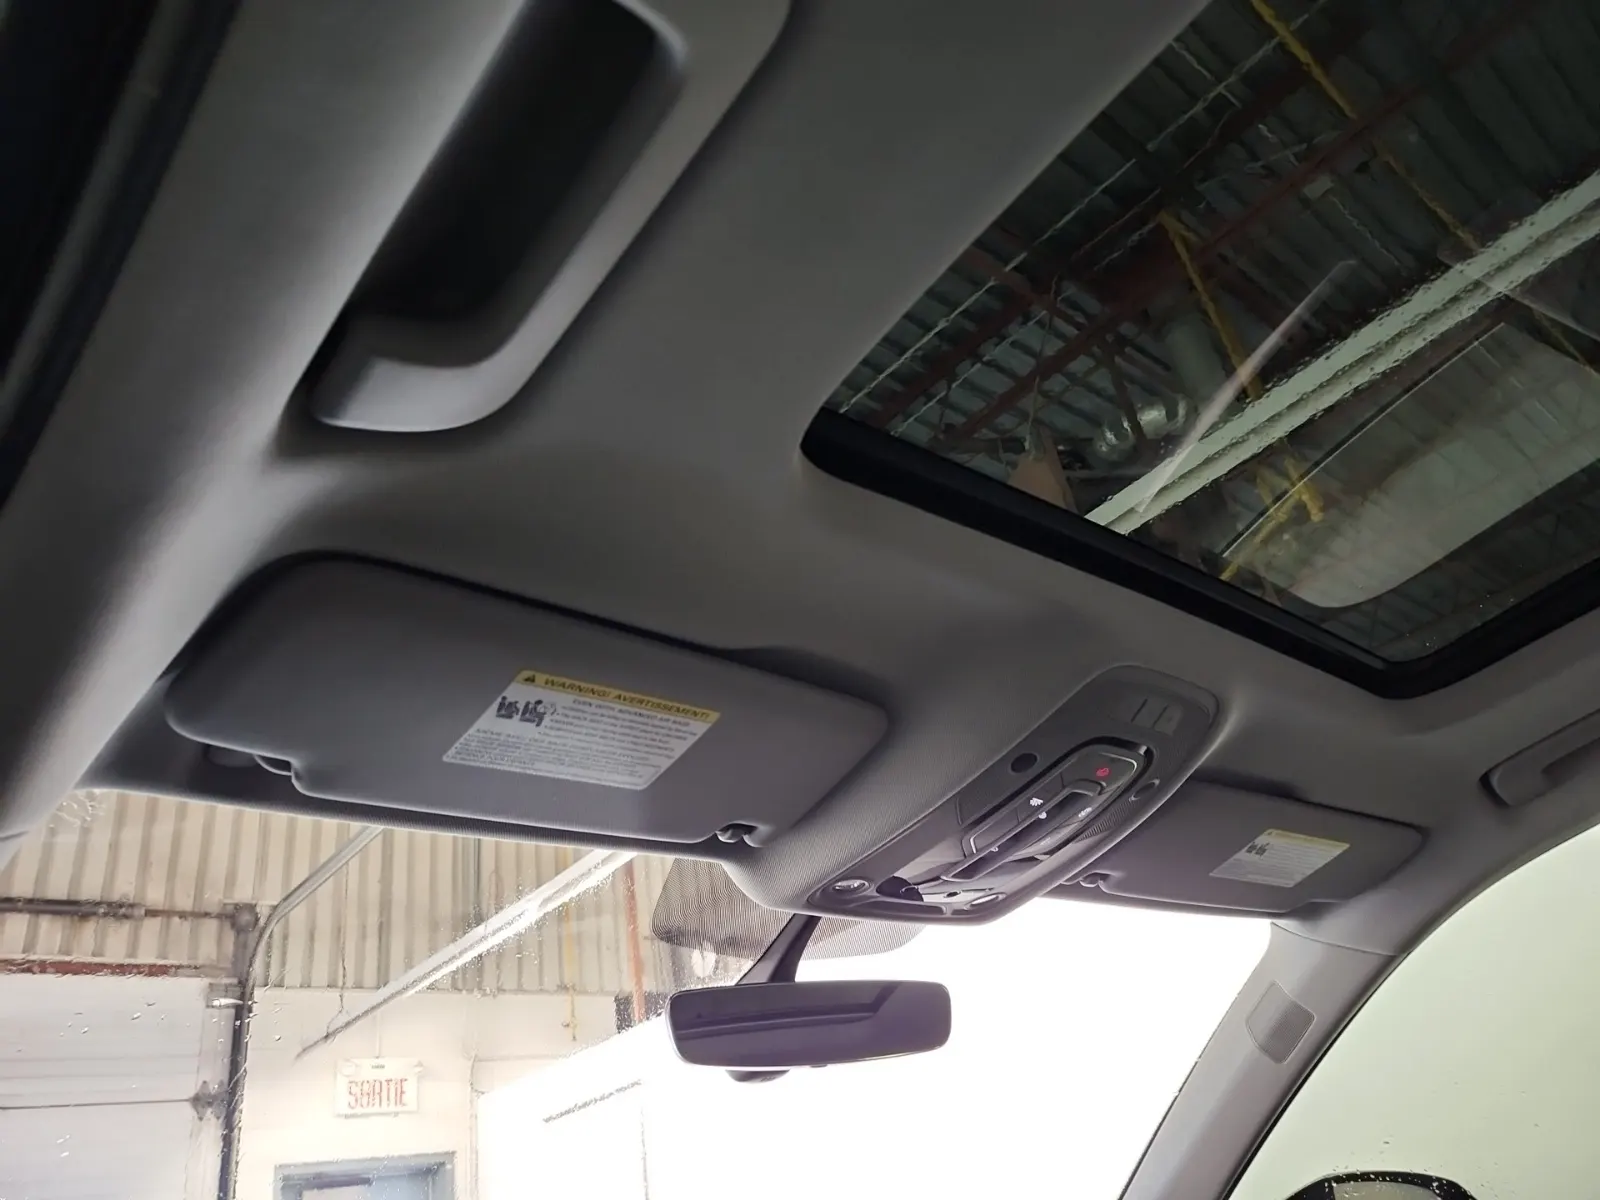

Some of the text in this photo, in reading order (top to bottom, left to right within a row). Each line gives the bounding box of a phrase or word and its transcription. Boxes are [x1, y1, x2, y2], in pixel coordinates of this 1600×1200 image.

[544, 678, 710, 719] WARNING! AVERTISSEMENT!
[348, 1078, 408, 1109] SORTIE
